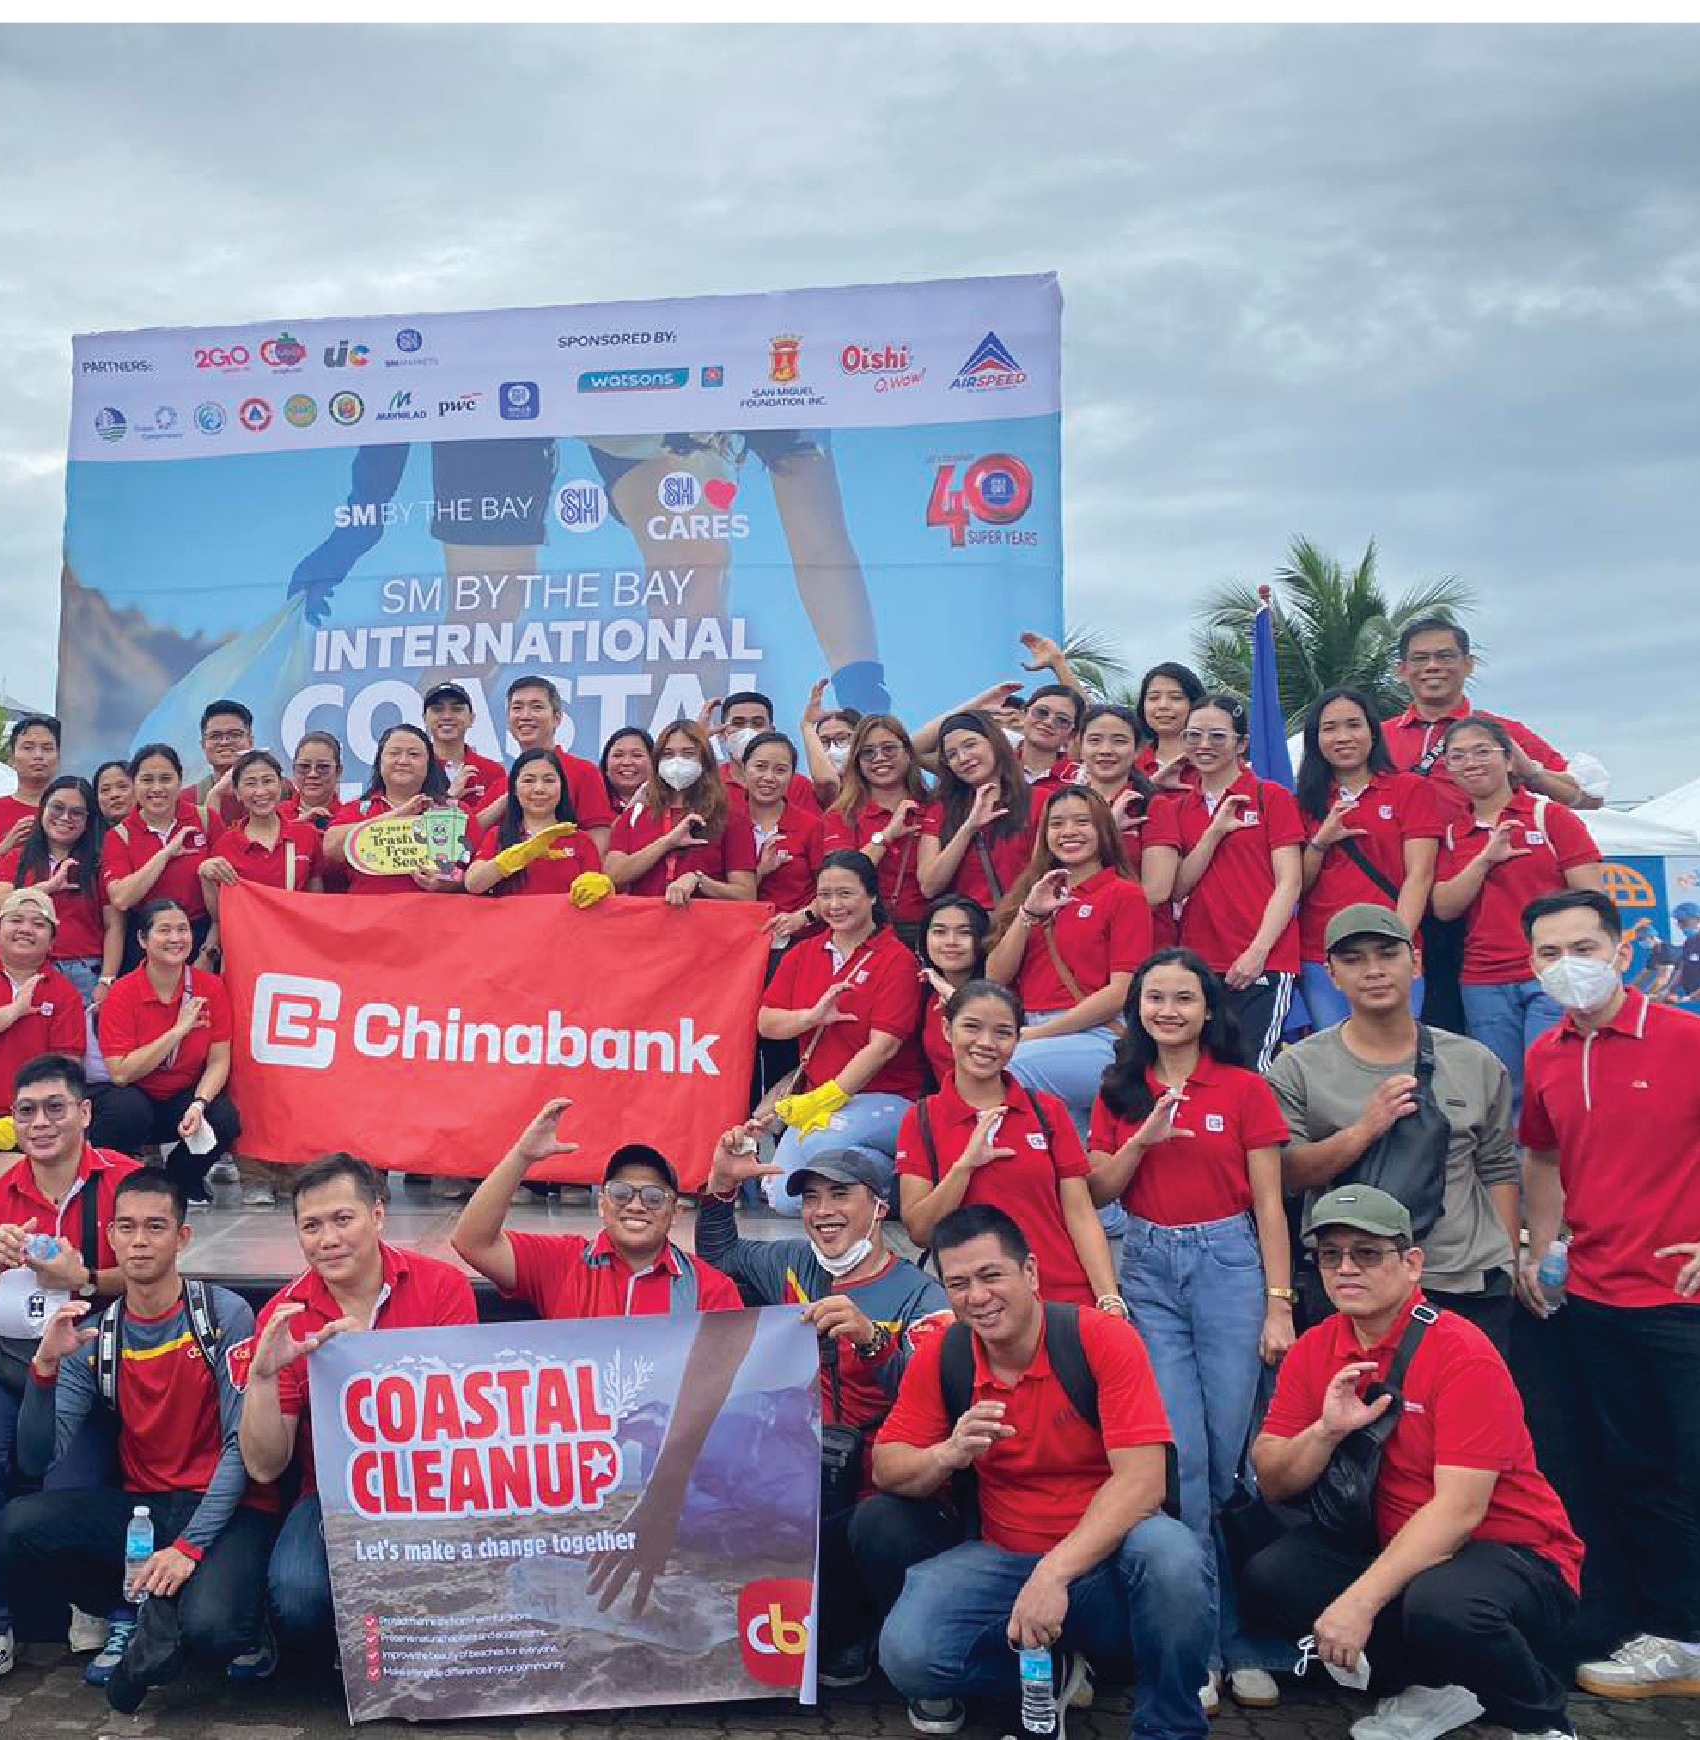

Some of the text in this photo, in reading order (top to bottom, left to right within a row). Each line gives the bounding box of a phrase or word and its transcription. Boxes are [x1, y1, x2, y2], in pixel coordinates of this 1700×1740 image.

[557, 331, 678, 348] SPONSORED BY:
[82, 361, 154, 374] PARTNERS:
[841, 345, 909, 371] Oishi
[590, 371, 675, 387] watsons
[751, 386, 815, 398] SAN MIGUEL
[948, 373, 1027, 389] AIRSPEED
[375, 408, 428, 421] MAYNILAD
[438, 398, 477, 418] pwc
[334, 503, 377, 529] SM
[380, 502, 414, 525] BY
[423, 498, 474, 522] THE
[481, 496, 534, 521] BAY
[646, 515, 750, 541] CARES
[382, 569, 696, 614] SM BY THE BAY
[313, 616, 764, 673] INTERNATIONAL
[353, 1003, 721, 1076] Chinabank
[344, 1364, 613, 1444] COASTAL
[351, 1439, 618, 1515] CLEANUP
[355, 1529, 637, 1562] Let's make a change together
